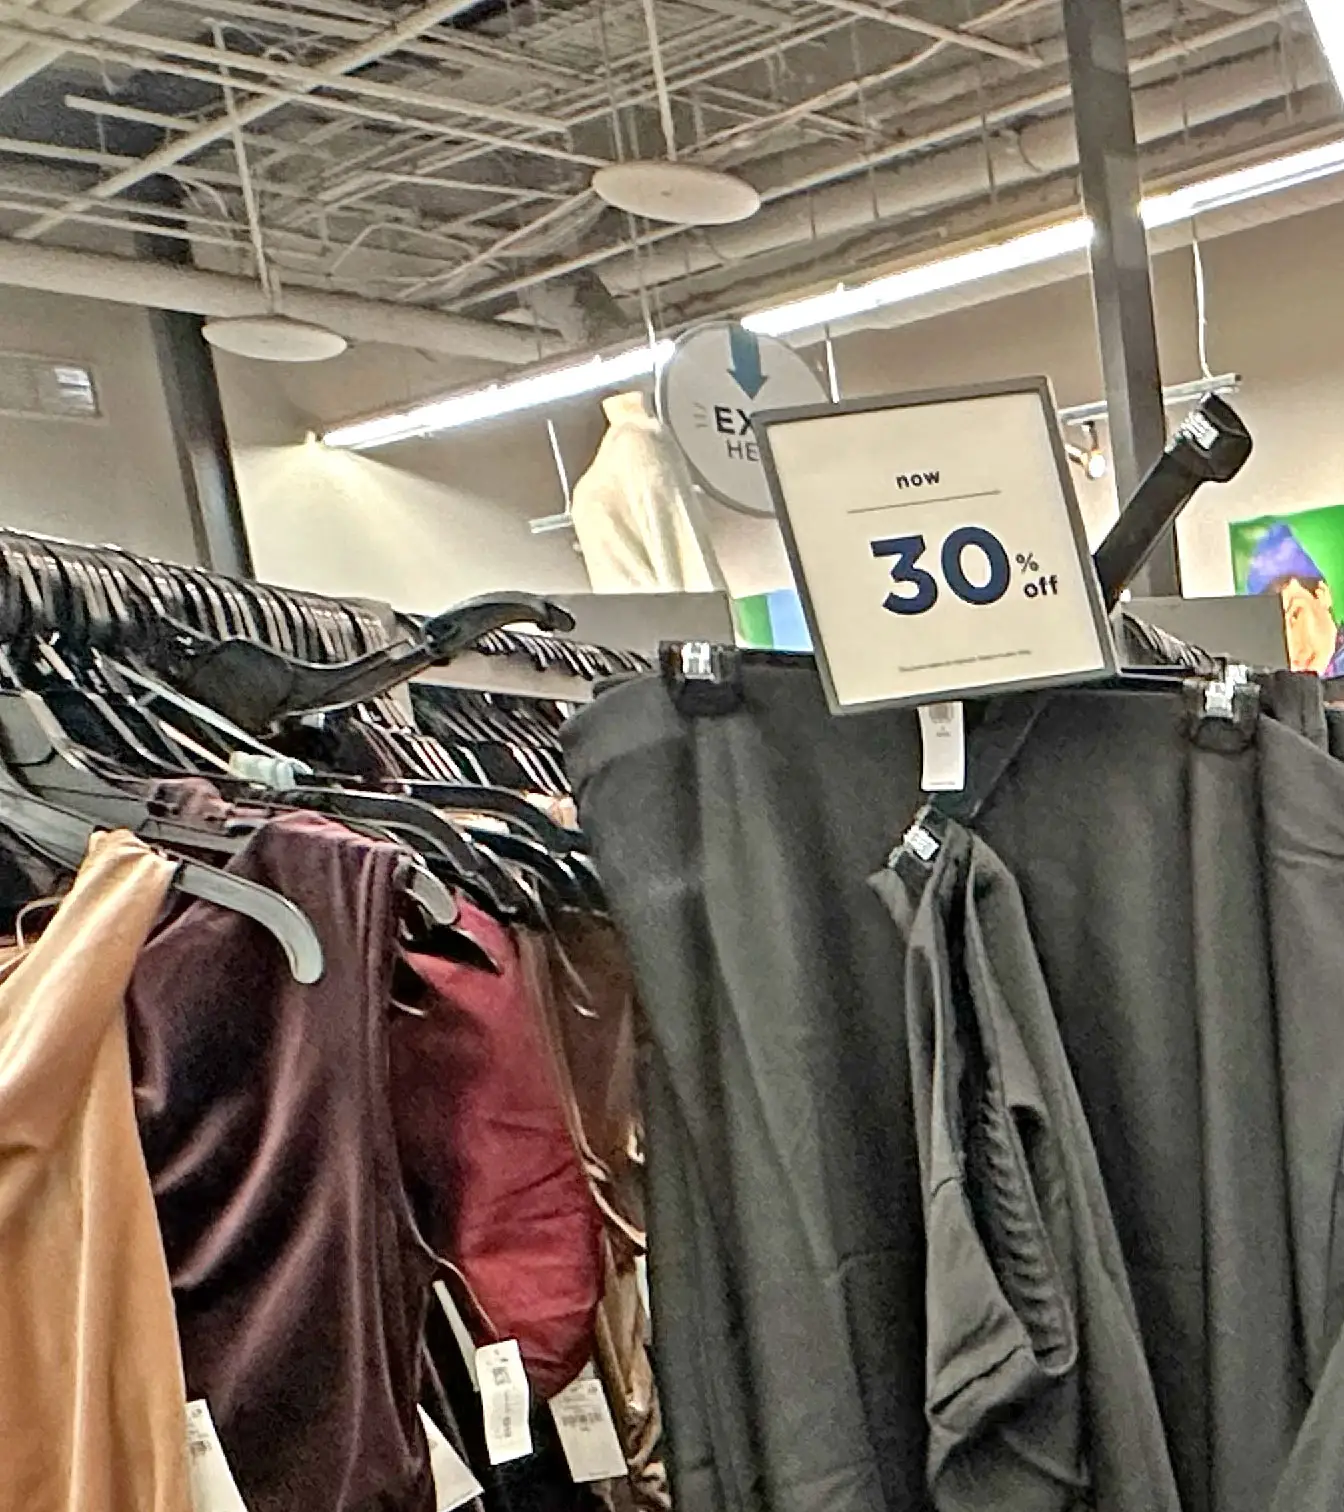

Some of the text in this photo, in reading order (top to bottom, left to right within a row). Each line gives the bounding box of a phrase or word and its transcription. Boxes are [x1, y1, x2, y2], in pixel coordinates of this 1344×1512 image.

[896, 469, 941, 490] now
[870, 526, 1010, 616] 30
[1023, 574, 1059, 599] off
